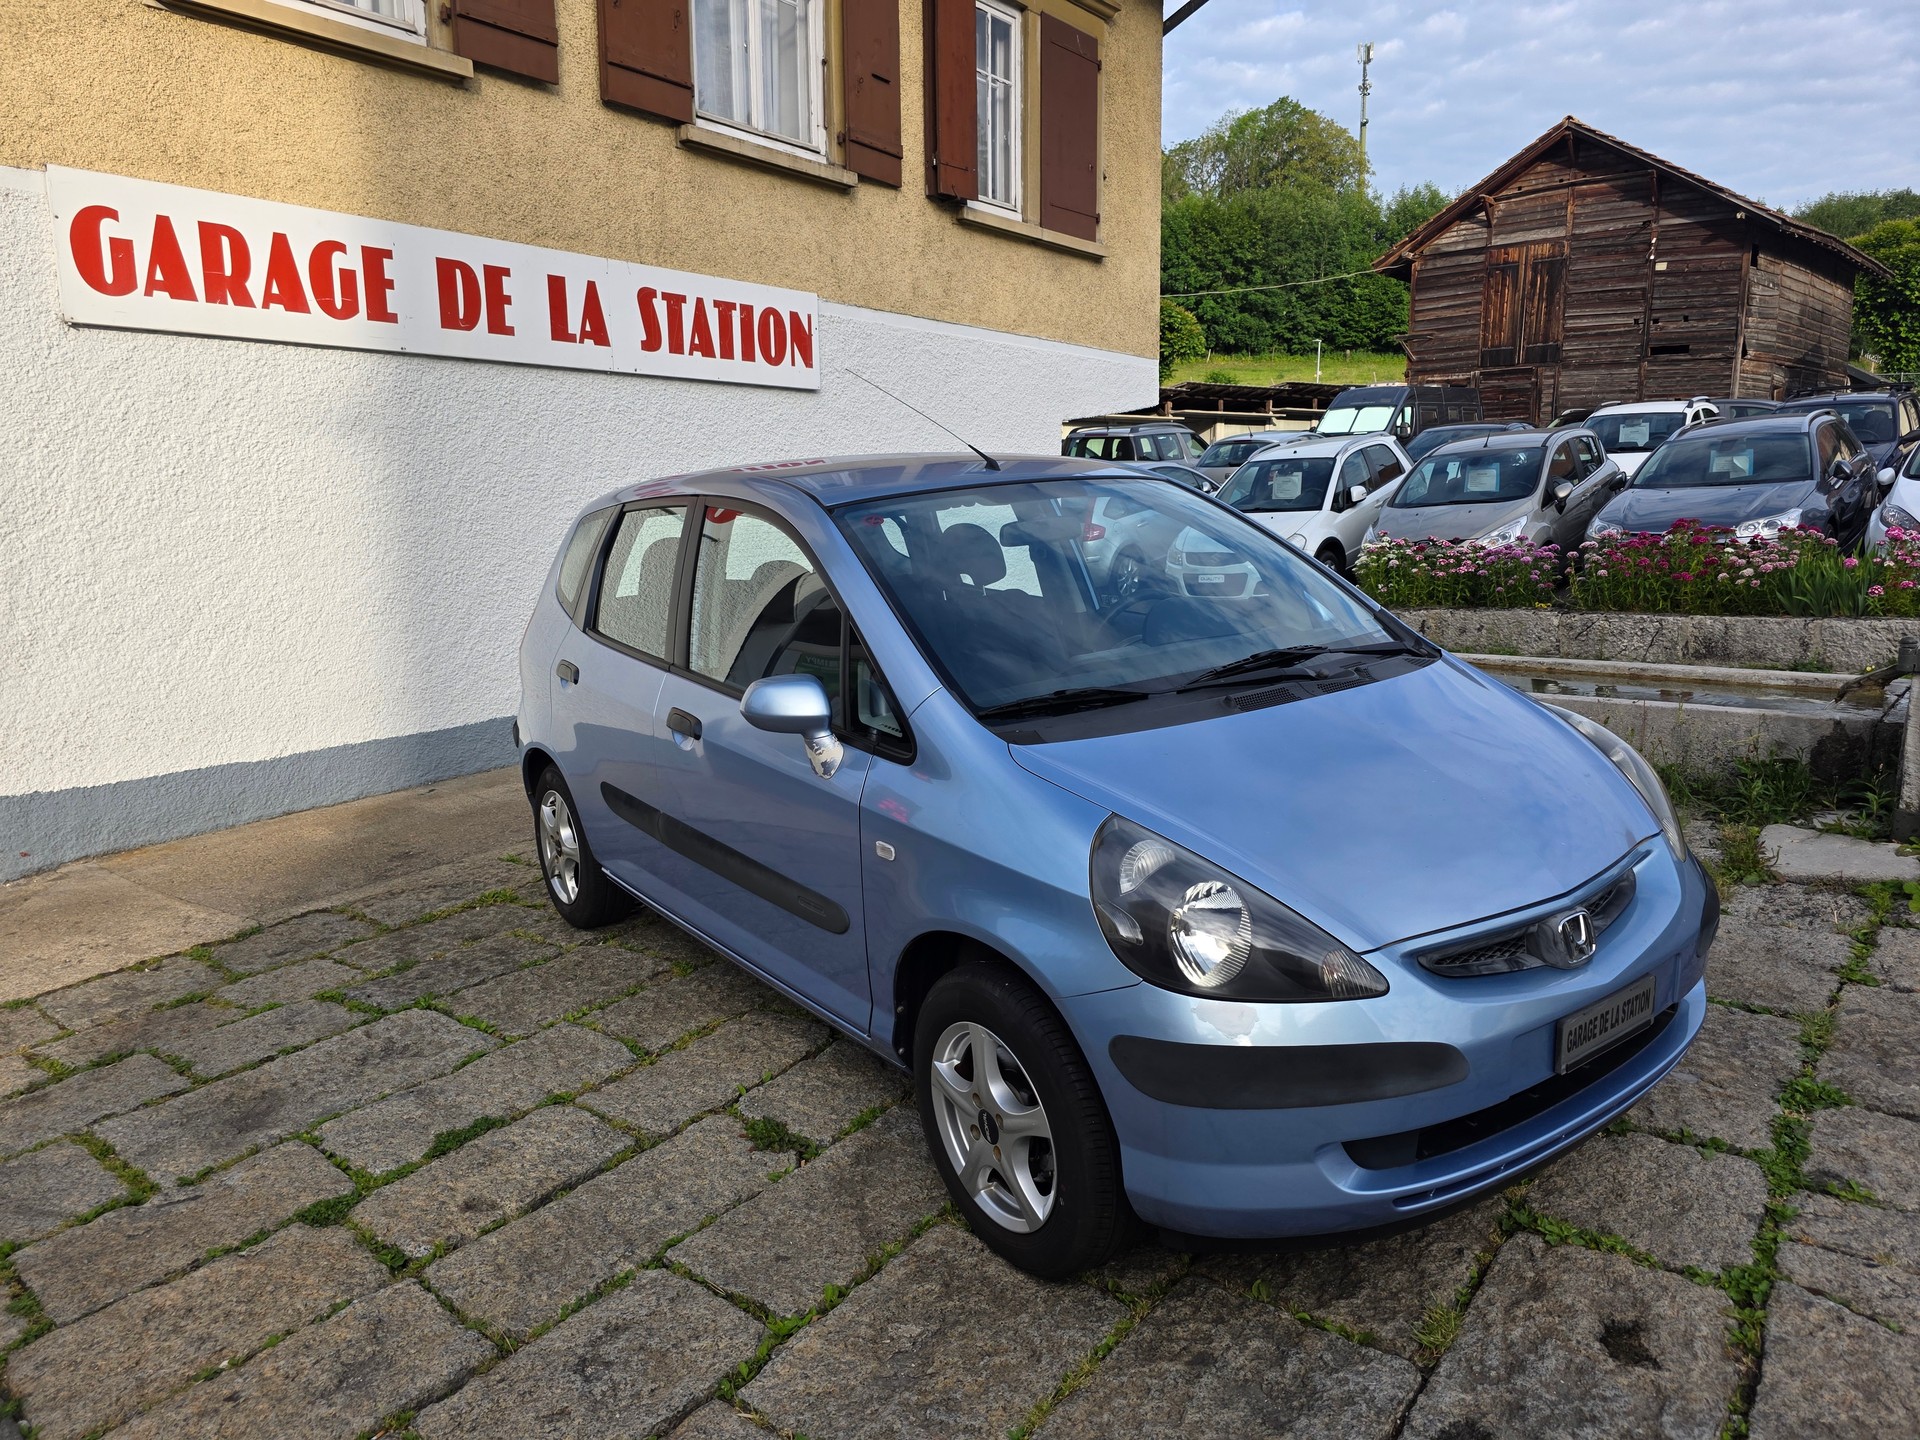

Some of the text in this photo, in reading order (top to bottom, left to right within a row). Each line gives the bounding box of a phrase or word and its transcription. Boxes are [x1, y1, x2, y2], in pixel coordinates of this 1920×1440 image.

[69, 204, 814, 369] GARAGE DE LA STATION
[1566, 988, 1651, 1053] GARAGE DE LA STATION
